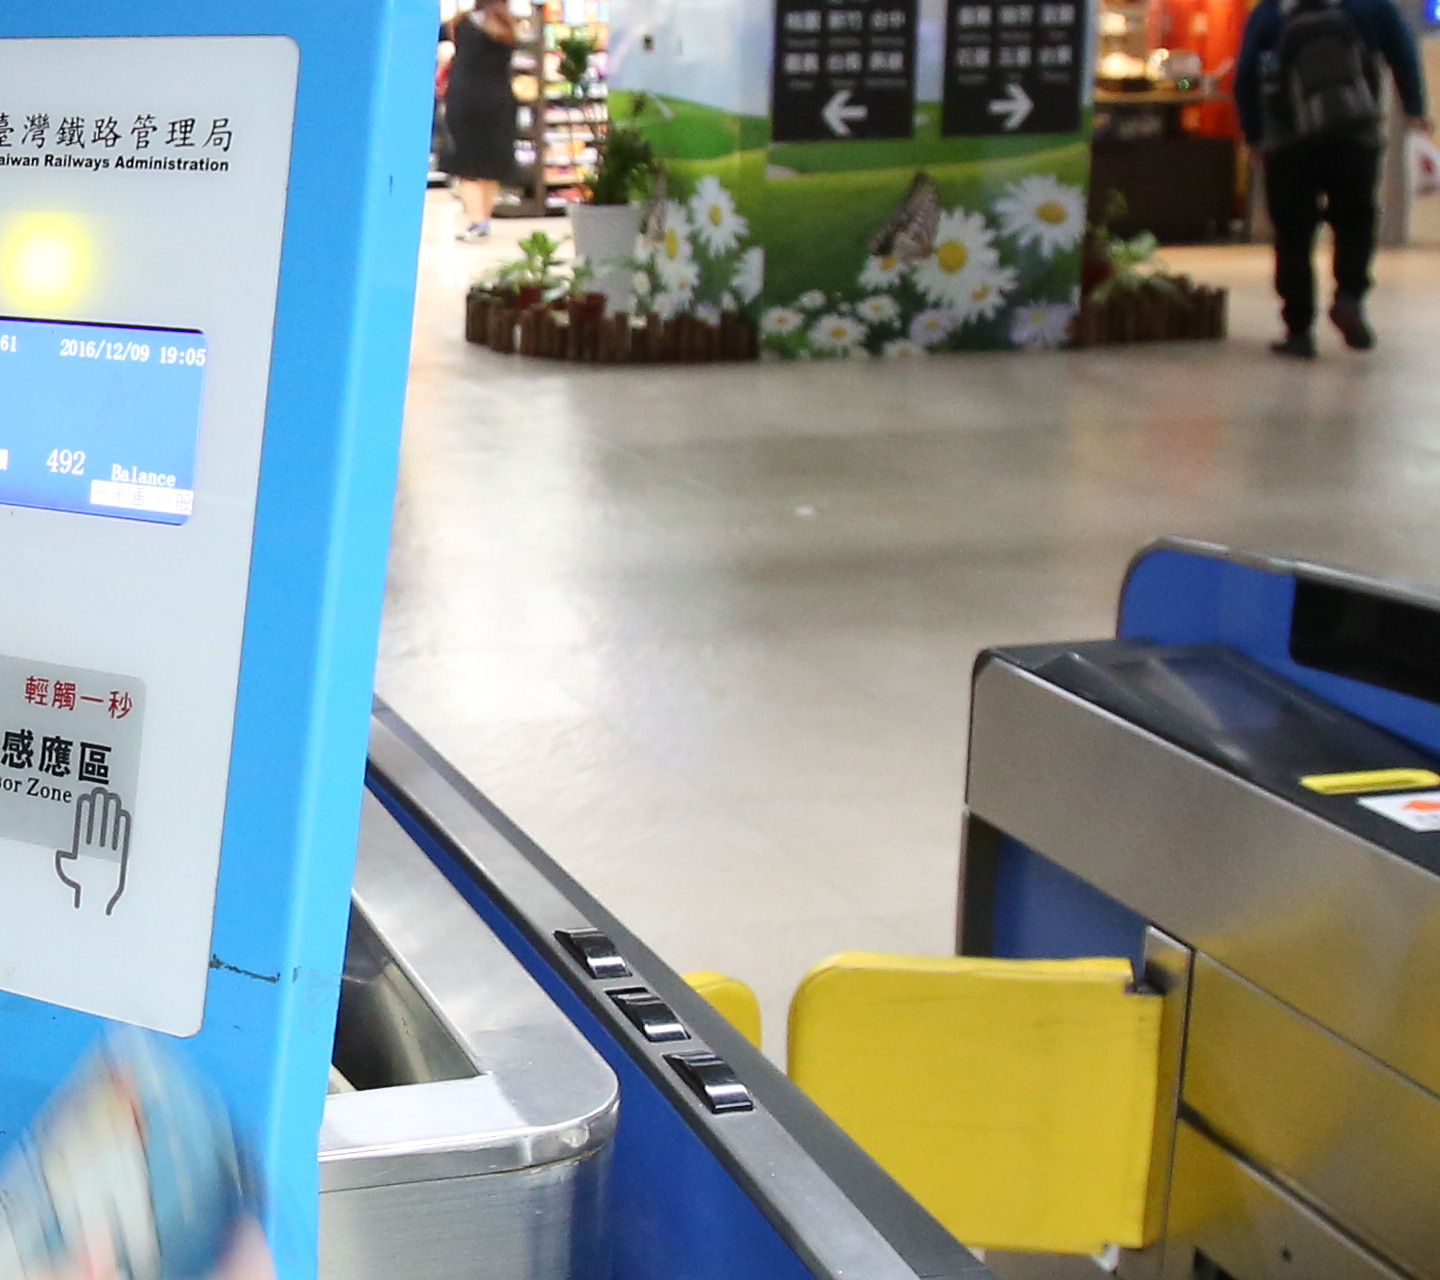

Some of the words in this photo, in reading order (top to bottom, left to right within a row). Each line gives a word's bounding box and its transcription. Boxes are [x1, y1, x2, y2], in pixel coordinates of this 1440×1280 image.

[44, 154, 110, 172] Railways
[115, 156, 229, 172] Administration
[59, 338, 150, 363] 2016/12/09
[159, 346, 207, 367] 19:05
[46, 448, 87, 476] 492
[110, 463, 176, 488] Balance
[24, 675, 134, 719] 輕觸一秒
[26, 777, 73, 804] Zone
